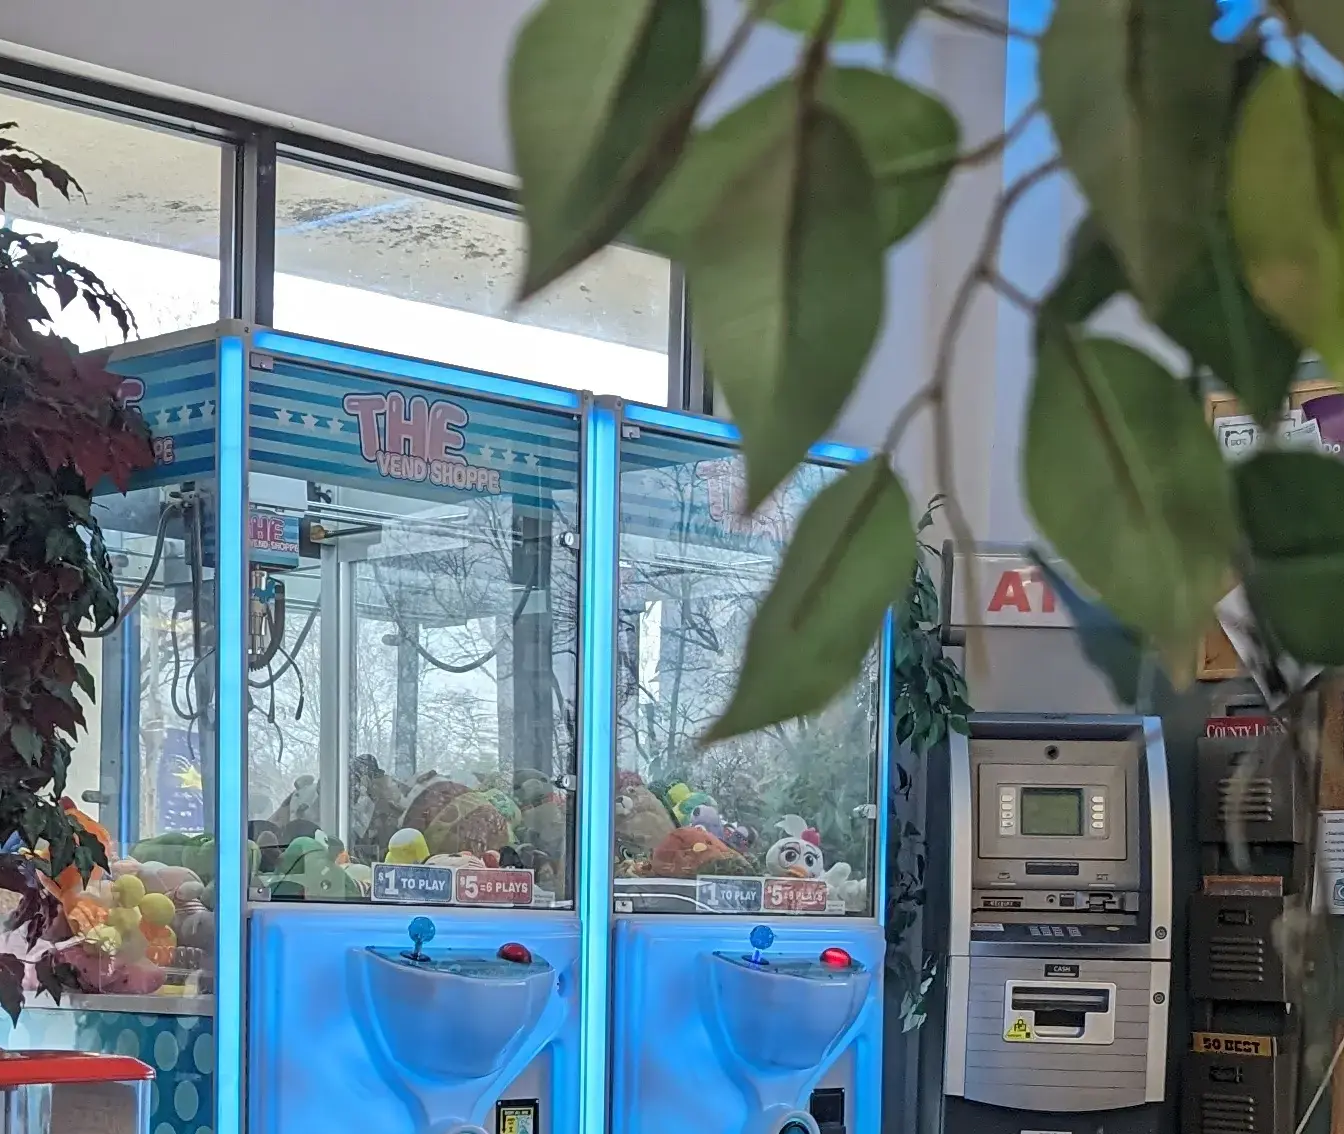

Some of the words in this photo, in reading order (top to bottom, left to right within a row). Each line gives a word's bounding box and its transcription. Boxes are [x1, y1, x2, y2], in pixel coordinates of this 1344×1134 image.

[342, 390, 470, 465] THE
[375, 450, 430, 483] VEND
[429, 458, 502, 495] SHOPPE
[250, 515, 286, 544] HE
[987, 569, 1056, 613] AT
[378, 868, 399, 895] $1
[400, 878, 416, 890] TO
[418, 879, 446, 892] PLAY
[495, 882, 528, 893] PLAYS
[720, 889, 733, 901] TO
[734, 889, 757, 902] PLAY
[795, 889, 823, 902] PLAYS
[1053, 965, 1071, 973] CASH
[1202, 1037, 1222, 1051] 50
[1223, 1039, 1261, 1054] BEST
